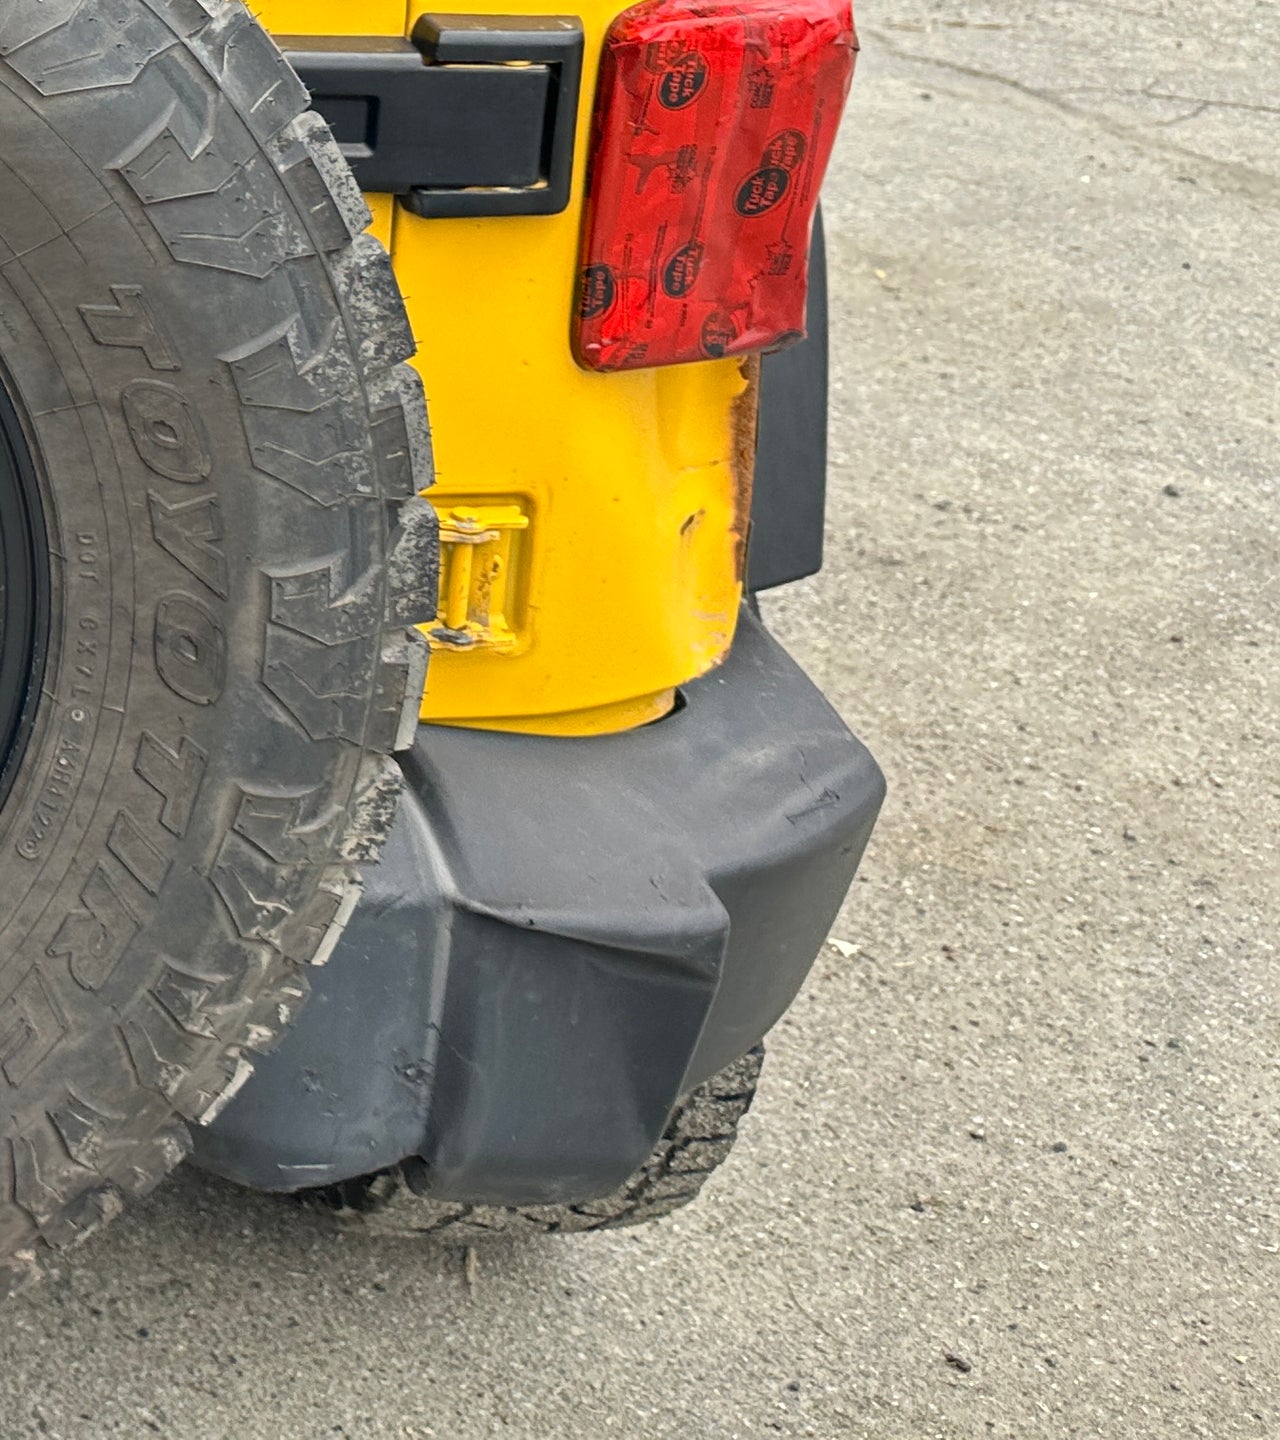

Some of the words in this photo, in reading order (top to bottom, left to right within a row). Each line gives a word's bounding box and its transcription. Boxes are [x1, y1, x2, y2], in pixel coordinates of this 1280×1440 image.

[668, 64, 687, 103] Tape
[682, 59, 699, 97] Tuck
[770, 139, 783, 167] uck
[744, 176, 765, 211] Tuck
[760, 172, 780, 206] Tape
[590, 270, 607, 310] Tape
[78, 284, 226, 706] TOYO
[76, 532, 99, 585] DOT
